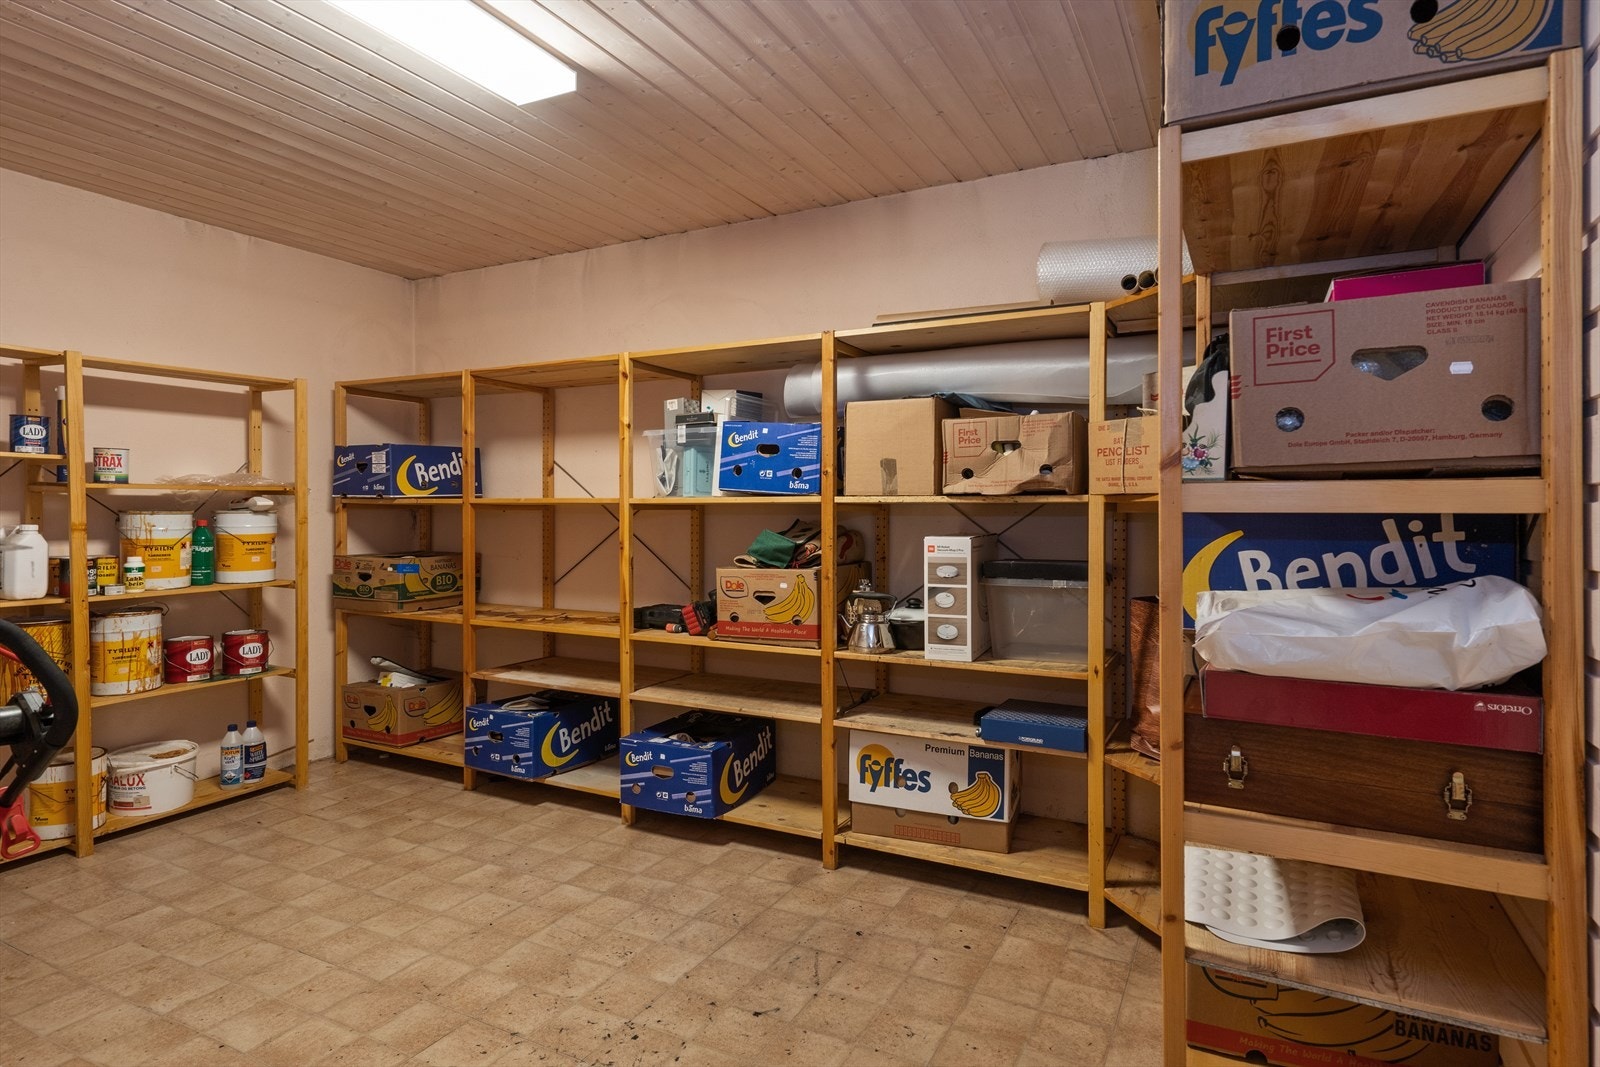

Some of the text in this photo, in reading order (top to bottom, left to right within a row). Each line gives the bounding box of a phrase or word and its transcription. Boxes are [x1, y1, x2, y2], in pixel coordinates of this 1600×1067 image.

[1425, 294, 1508, 308] CAVENDISH BANANAS
[1426, 306, 1461, 315] PRODUCT
[1476, 301, 1514, 310] ECUADOR
[1266, 325, 1313, 343] First
[1266, 341, 1320, 359] Price
[22, 427, 44, 436] LADY
[734, 430, 758, 443] Bendit
[958, 428, 978, 436] First
[958, 436, 980, 444] Price
[1096, 445, 1150, 457] PENCLIST
[94, 456, 122, 468] STRAX
[414, 452, 464, 487] Bendi
[1238, 514, 1477, 592] Bendit
[430, 563, 456, 571] BANANAS
[436, 575, 453, 585] BIO
[725, 580, 744, 590] Dole
[242, 645, 262, 655] LADY
[190, 651, 210, 662] LADY
[1488, 704, 1532, 715] Orrefors
[473, 717, 489, 728] Bendit
[559, 701, 613, 753] Bendit
[631, 751, 653, 763] Bendit
[733, 726, 772, 788] Bendit
[924, 744, 1004, 761] Premium Bananas
[859, 754, 931, 793] fyffes
[112, 774, 145, 786] ALUX
[1395, 1020, 1492, 1052] BANANAS
[1239, 1036, 1275, 1053] Making
[1279, 1044, 1300, 1056] The
[1303, 1050, 1332, 1062] World
[1336, 1056, 1344, 1064] A
